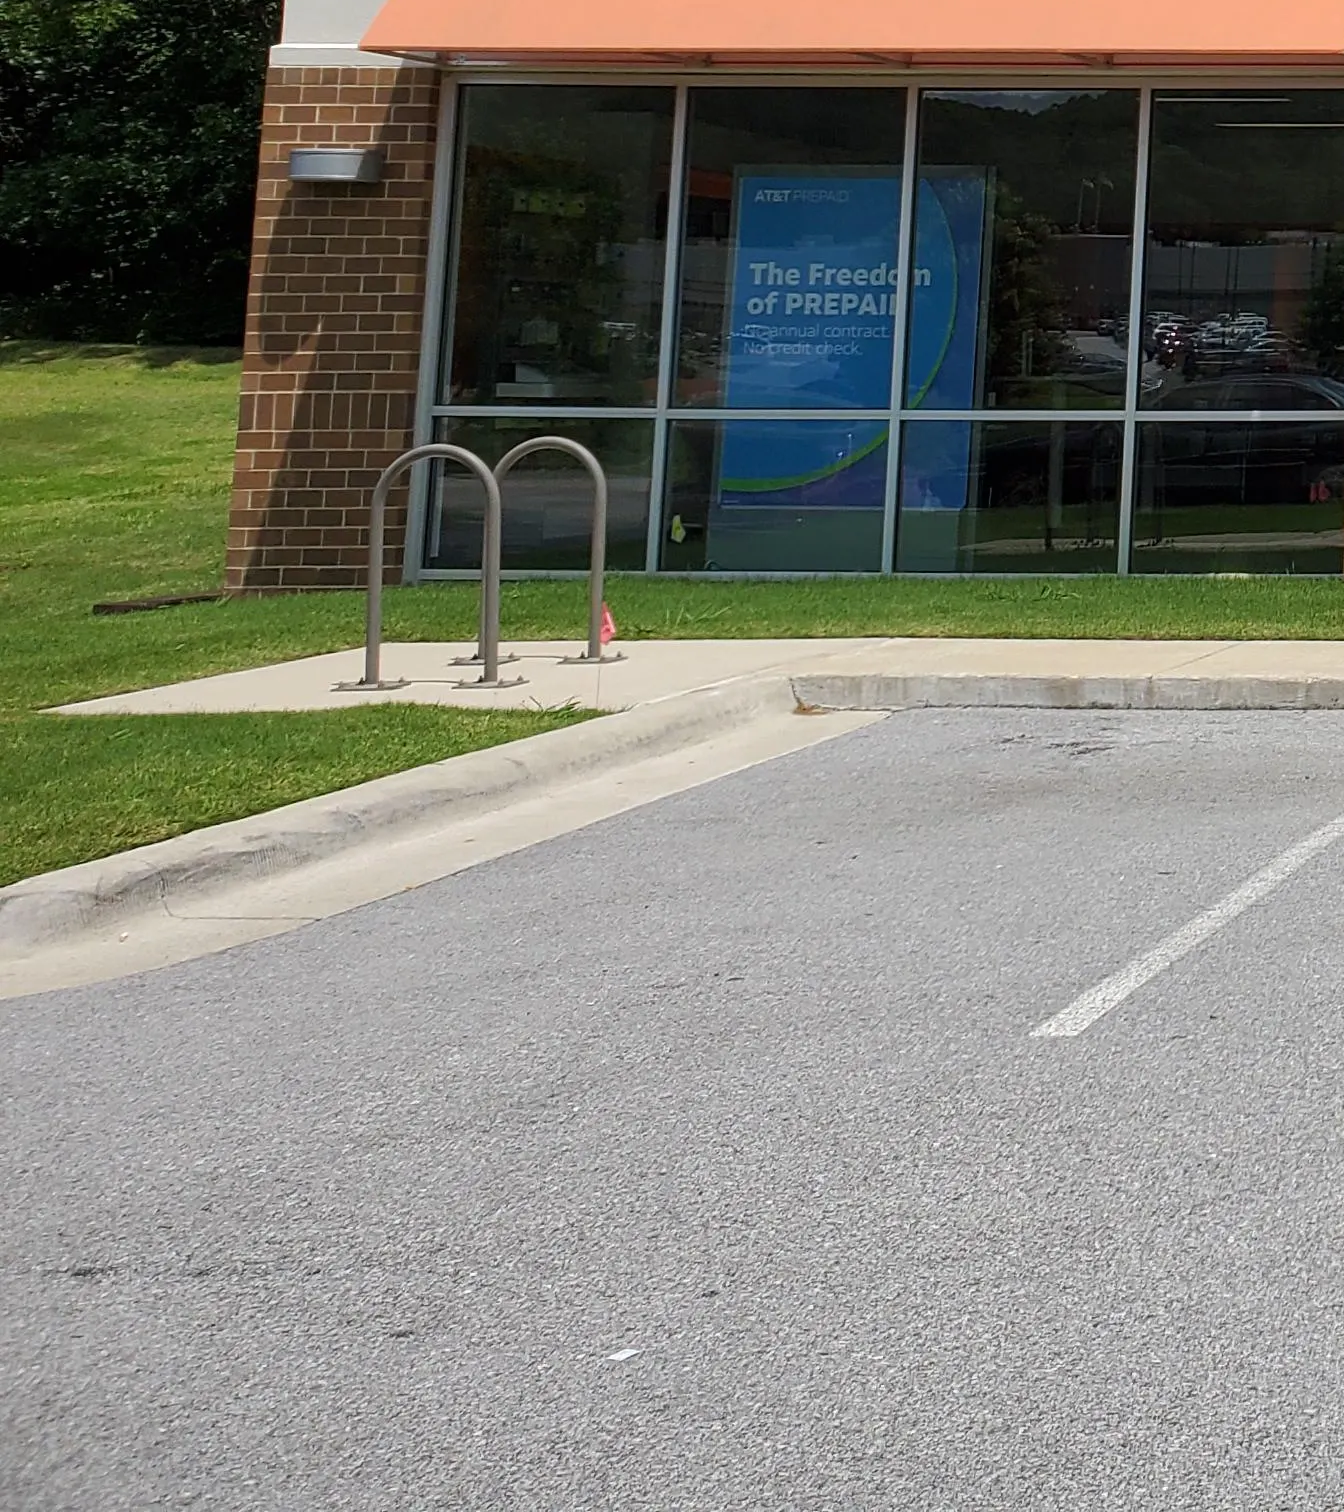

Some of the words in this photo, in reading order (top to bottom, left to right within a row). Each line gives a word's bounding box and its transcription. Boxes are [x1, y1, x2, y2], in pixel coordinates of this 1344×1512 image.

[754, 190, 791, 203] AT&T
[750, 262, 801, 286] The
[747, 291, 780, 316] of
[770, 324, 819, 338] annual
[743, 341, 764, 354] No
[767, 340, 812, 354] credit
